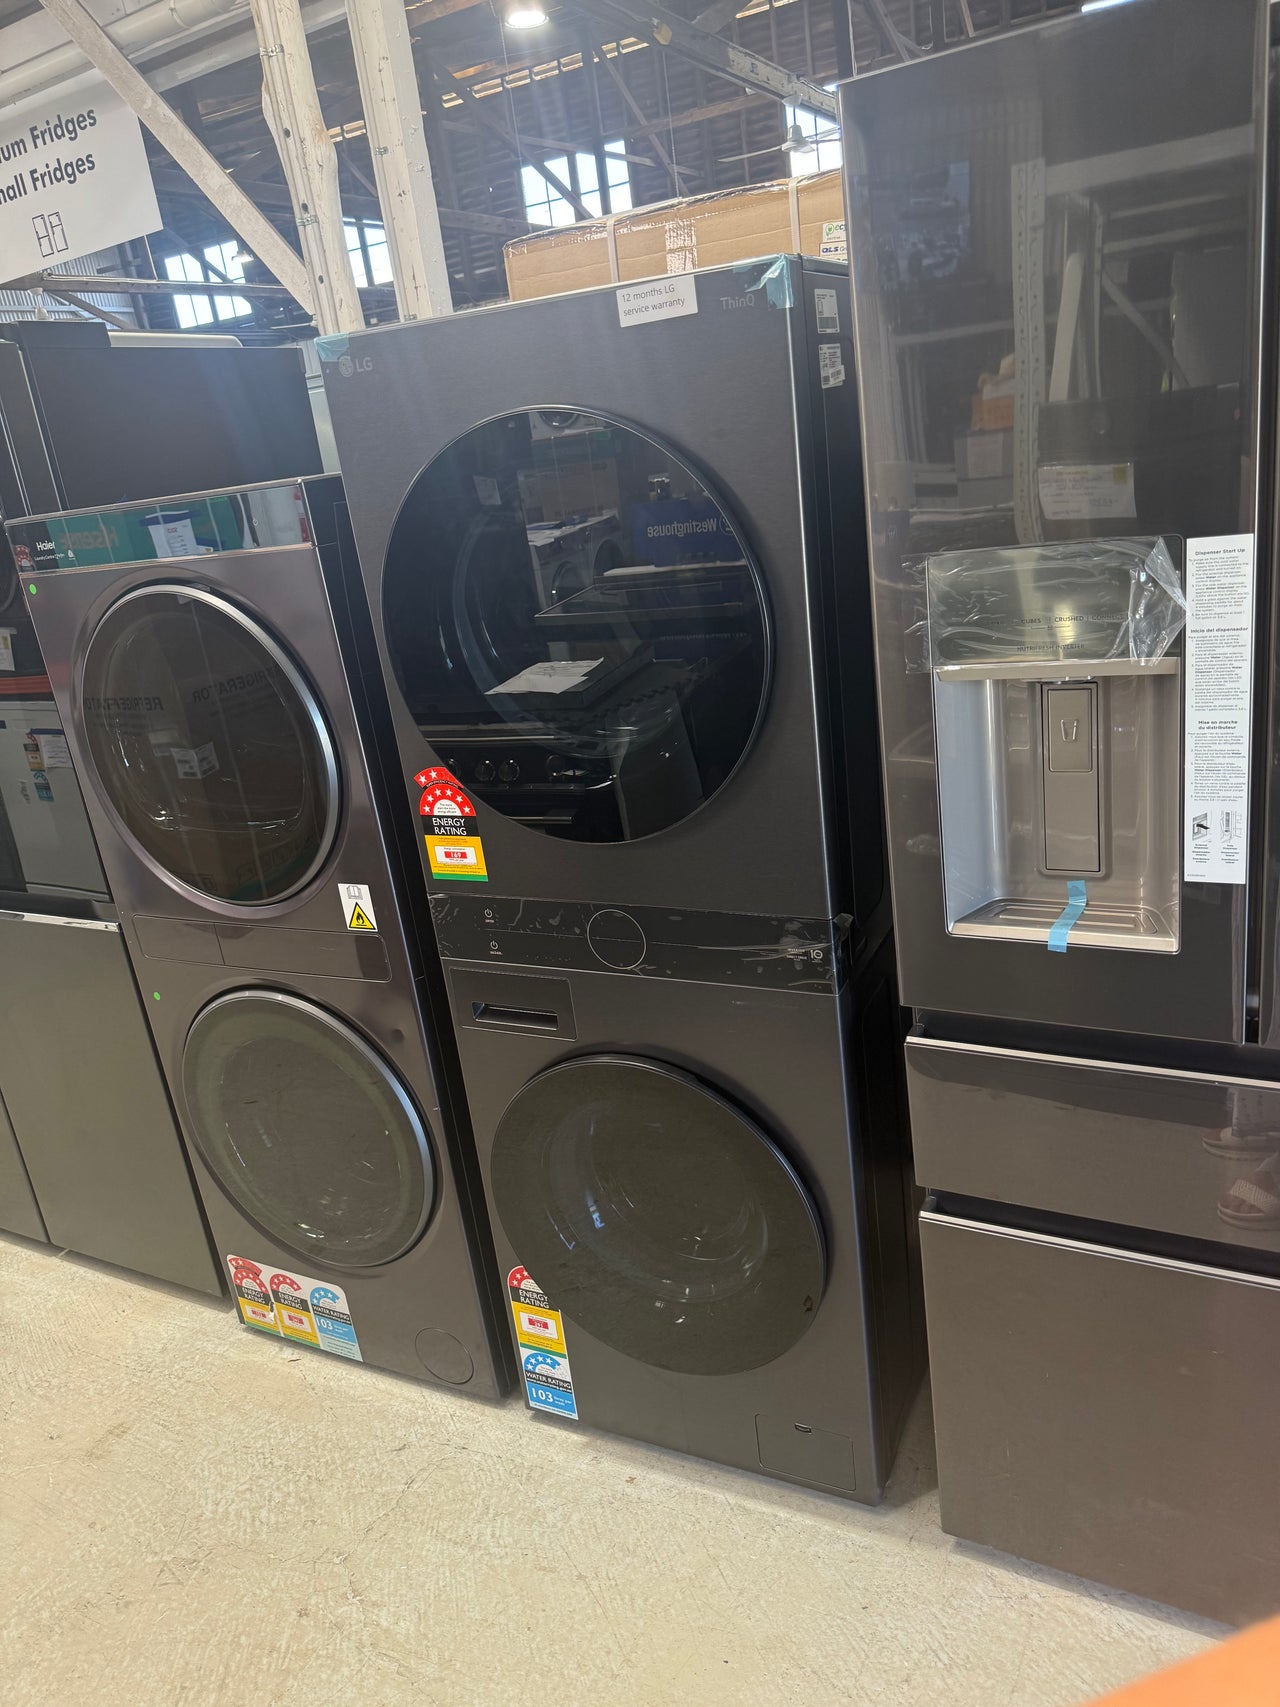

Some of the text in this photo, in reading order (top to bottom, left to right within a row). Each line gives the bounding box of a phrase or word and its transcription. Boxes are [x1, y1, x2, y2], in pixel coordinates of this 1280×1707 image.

[29, 109, 97, 149] Fridges
[29, 153, 96, 191] Fridges
[622, 283, 675, 303] 12 months LG
[623, 297, 685, 317] service warranty
[719, 293, 755, 311] ThinQ
[355, 356, 373, 373] LG
[1054, 615, 1084, 623] CRUSHED
[432, 817, 465, 827] ENERGY
[434, 827, 467, 836] RATING
[519, 1289, 548, 1301] ENERGY
[520, 1296, 550, 1309] RATING
[315, 1317, 333, 1330] 103
[525, 1371, 571, 1389] WATER RATING
[531, 1387, 553, 1402] 103
